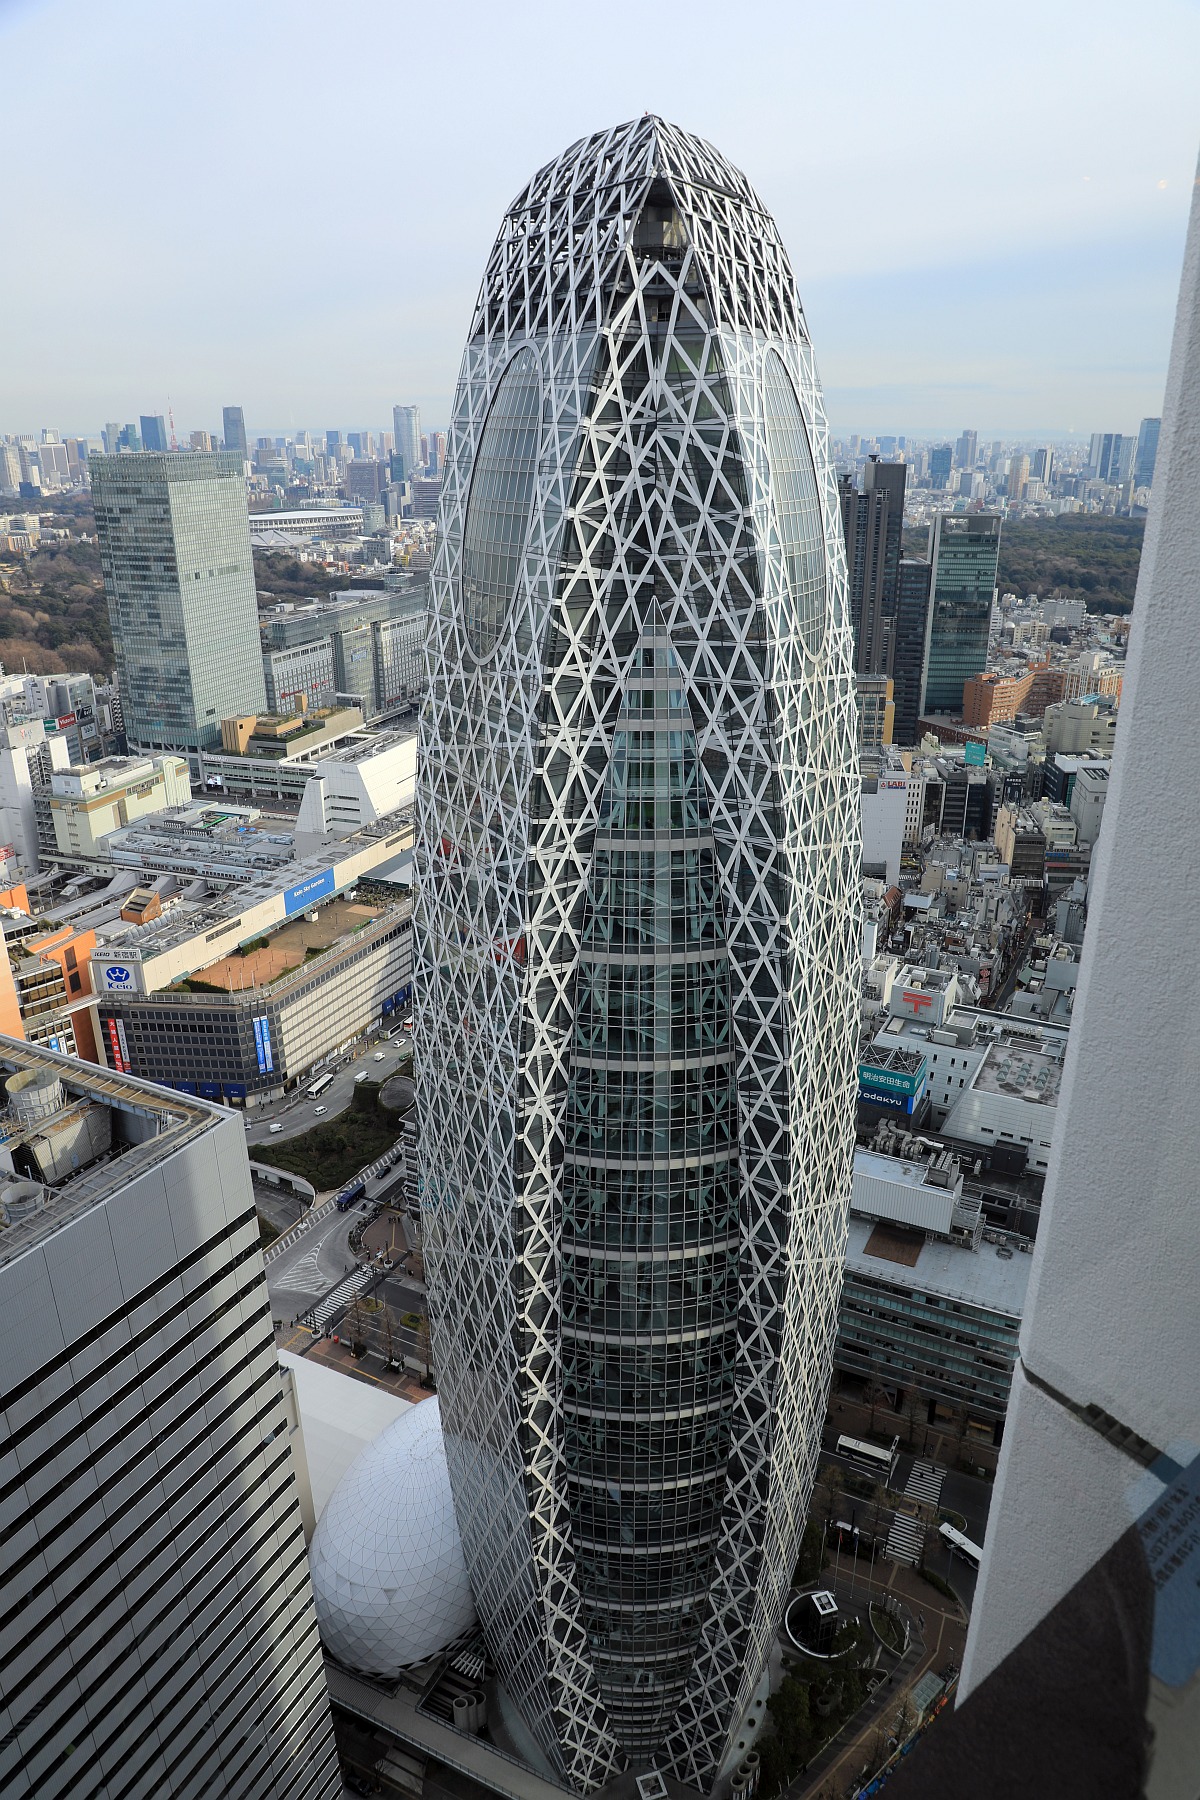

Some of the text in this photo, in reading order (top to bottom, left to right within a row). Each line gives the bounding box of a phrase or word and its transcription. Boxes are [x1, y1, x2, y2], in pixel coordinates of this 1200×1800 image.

[293, 889, 303, 898] Keio
[310, 878, 325, 888] Garden
[107, 982, 133, 990] Keio
[862, 1071, 911, 1089] 明治安田生命
